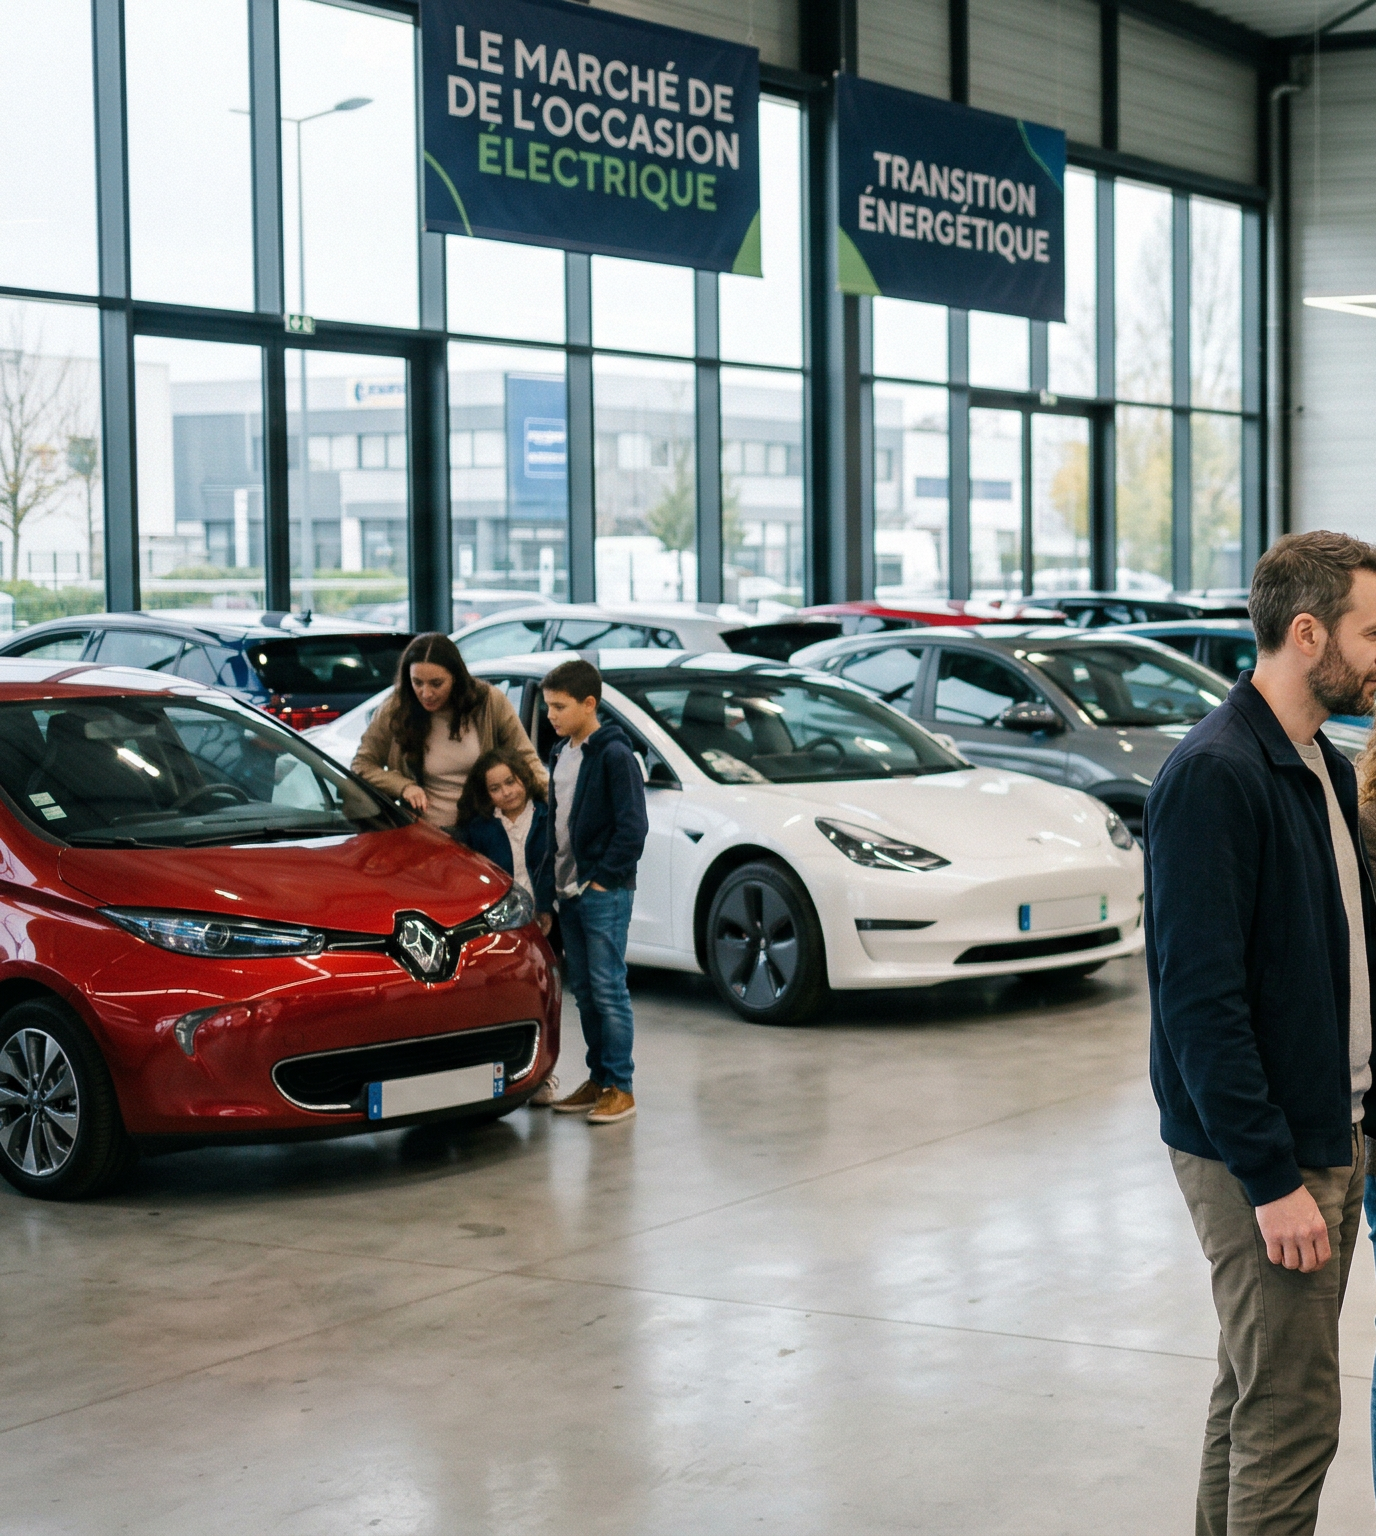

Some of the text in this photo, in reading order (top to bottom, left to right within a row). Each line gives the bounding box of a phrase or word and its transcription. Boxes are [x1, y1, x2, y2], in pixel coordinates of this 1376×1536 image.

[447, 76, 503, 124] DE
[455, 24, 734, 123] LE MARCHÉ DE
[478, 123, 717, 212] ÉLECTRIQUE
[873, 151, 1036, 217] TRANSITION
[857, 186, 1050, 264] ÉNERGÉTIQUE
